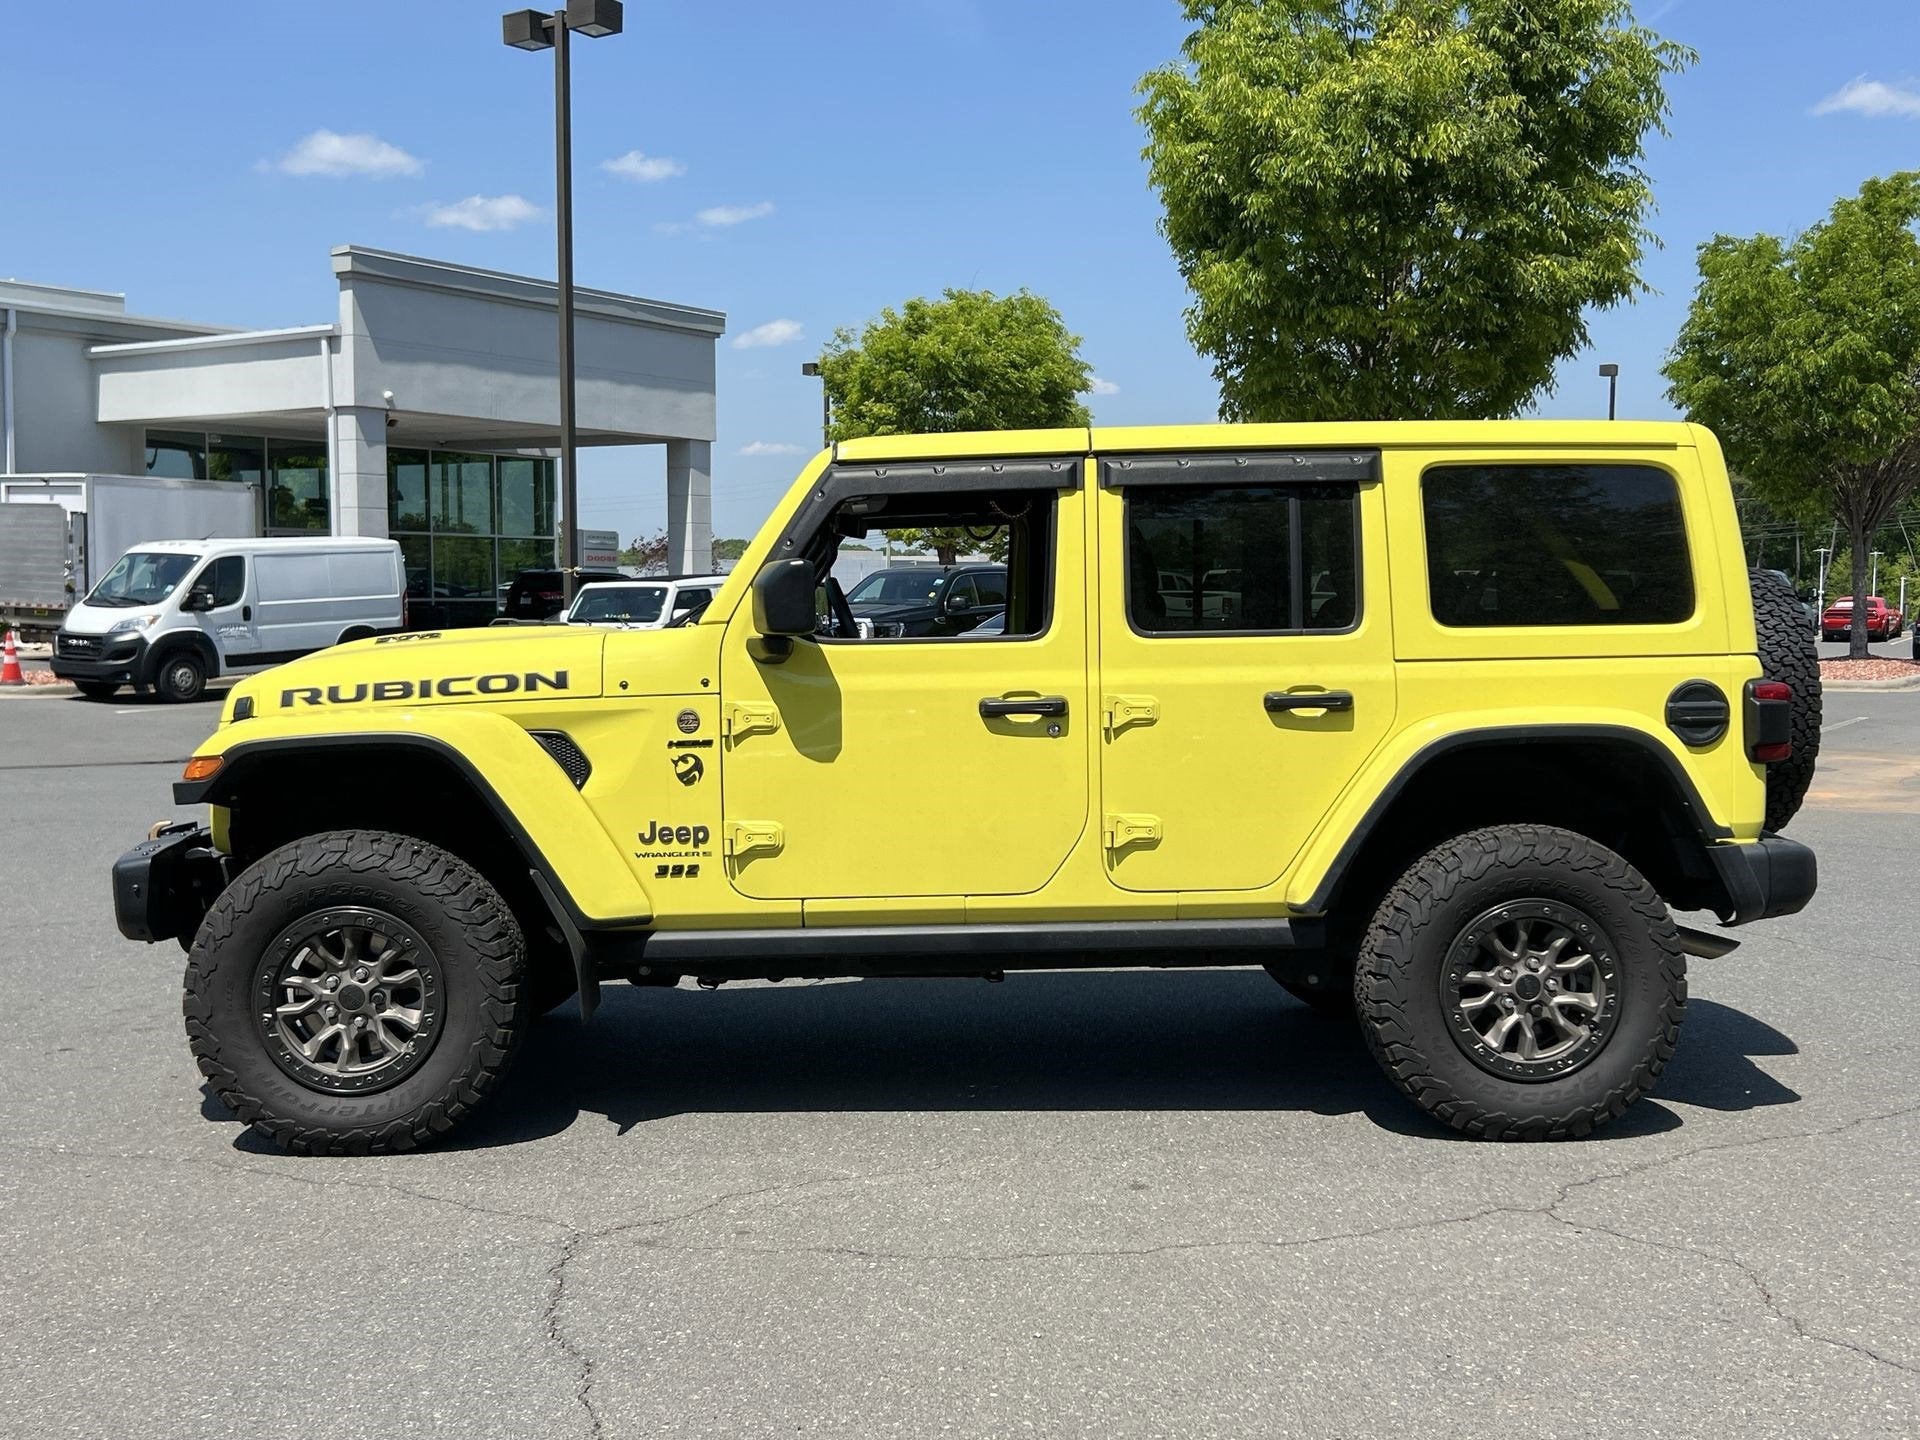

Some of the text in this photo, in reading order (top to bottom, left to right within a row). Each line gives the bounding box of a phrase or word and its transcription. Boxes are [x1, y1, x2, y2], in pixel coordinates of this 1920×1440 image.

[280, 670, 568, 708] RUBICON
[638, 820, 710, 849] Jeep
[654, 864, 700, 878] 392
